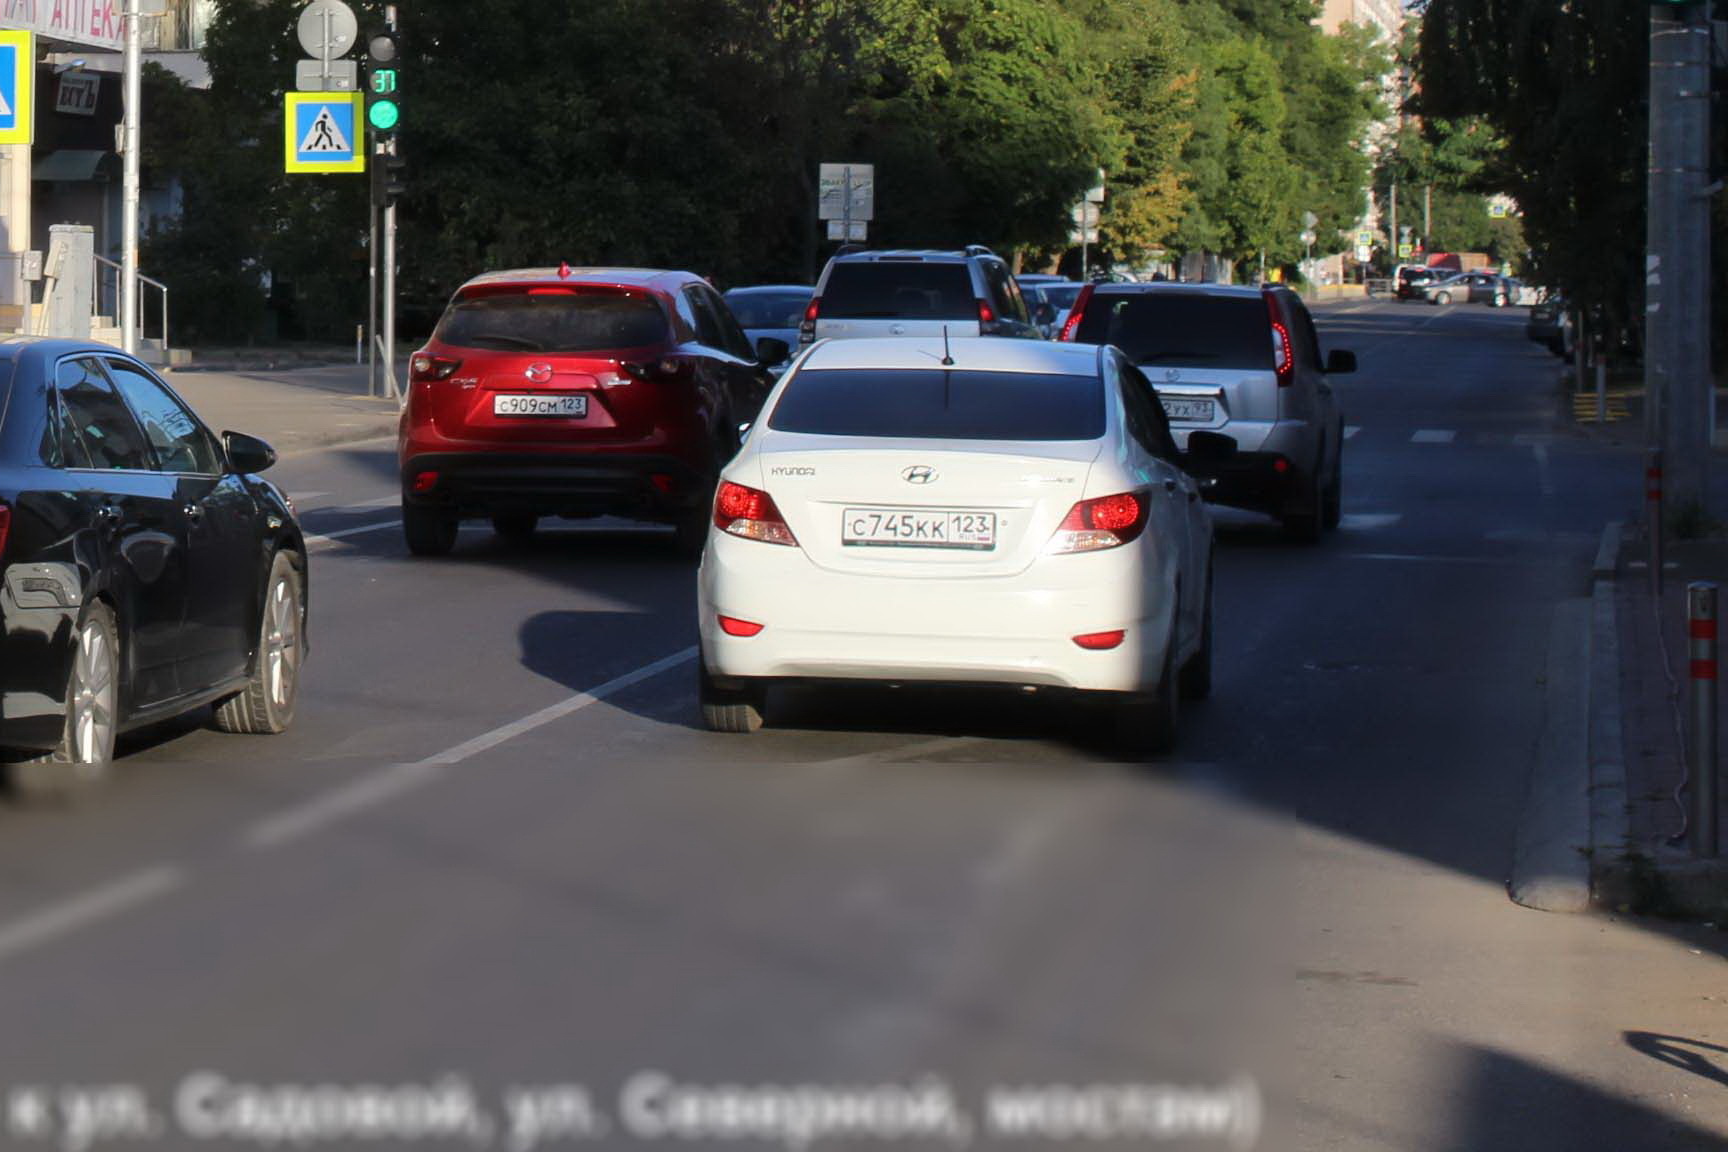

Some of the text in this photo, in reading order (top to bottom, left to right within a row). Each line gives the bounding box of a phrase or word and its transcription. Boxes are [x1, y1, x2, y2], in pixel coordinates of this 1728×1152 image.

[375, 69, 396, 93] 37
[500, 397, 583, 414] С909СМ 123
[852, 513, 987, 539] С745КК 123
